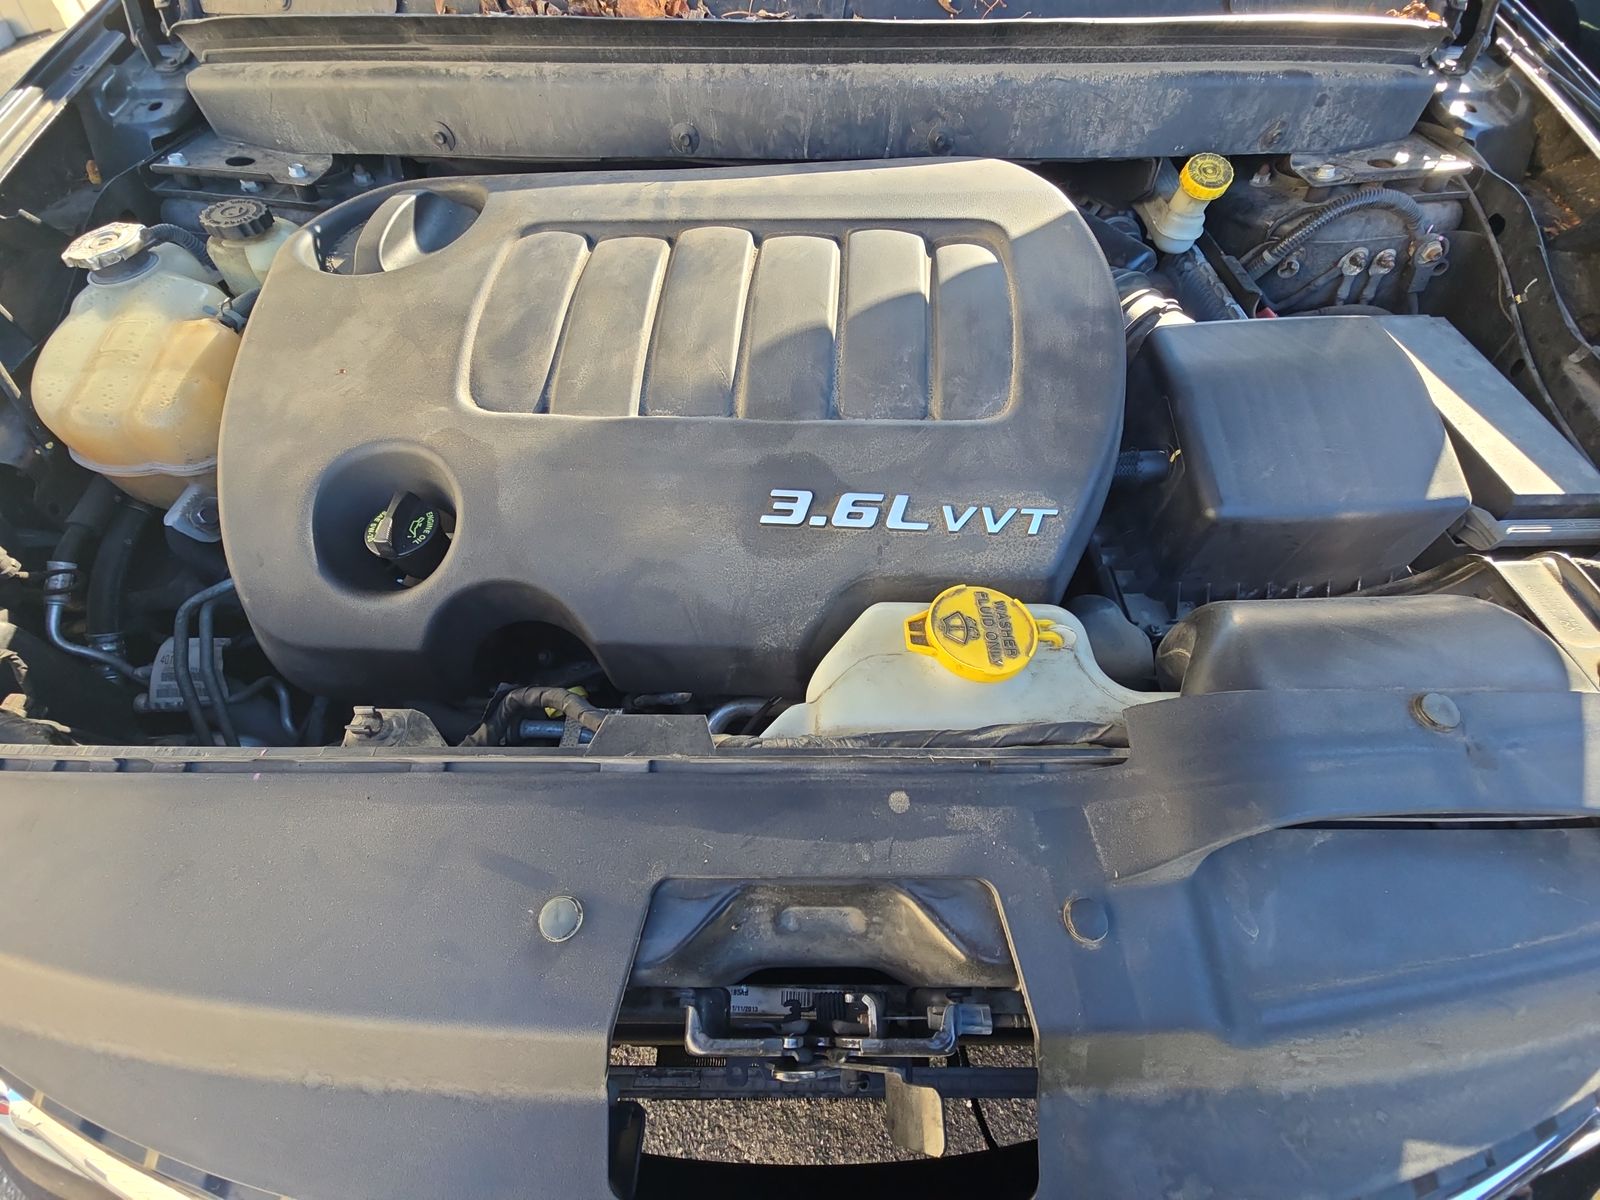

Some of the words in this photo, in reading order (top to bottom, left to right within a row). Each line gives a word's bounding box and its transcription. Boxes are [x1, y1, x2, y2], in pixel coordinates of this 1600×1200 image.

[422, 511, 435, 534] ENGINE
[760, 489, 930, 530] 3.6L
[942, 505, 1059, 535] VVT
[412, 534, 426, 545] OIL
[974, 591, 994, 628] FLUID
[985, 630, 1004, 667] ONLY
[993, 600, 1019, 659] WASHER
